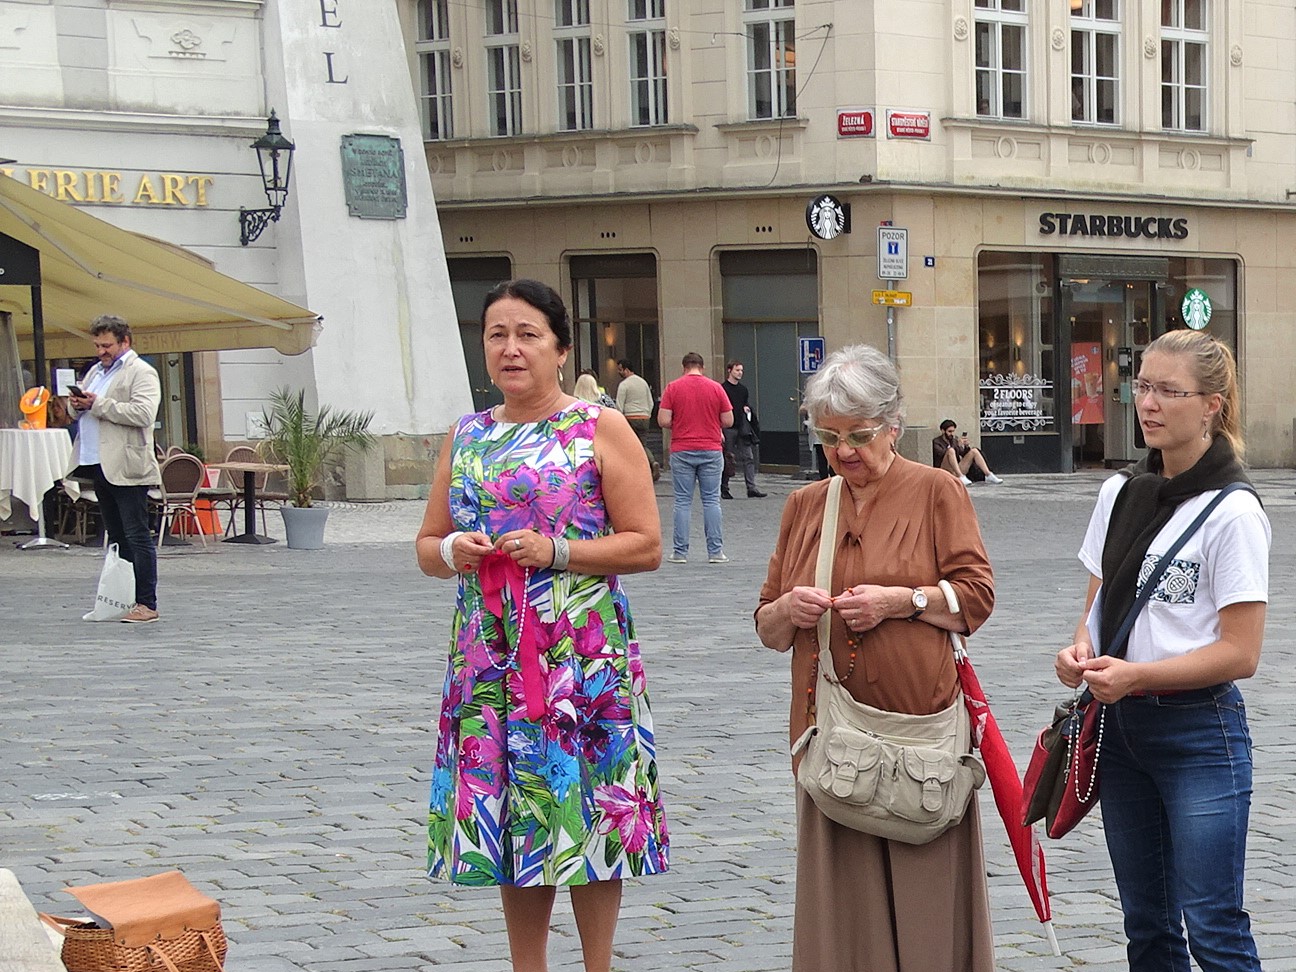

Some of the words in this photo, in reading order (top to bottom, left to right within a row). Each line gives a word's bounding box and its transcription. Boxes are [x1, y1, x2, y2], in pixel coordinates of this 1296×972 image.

[0, 167, 125, 203] ERIE
[133, 174, 214, 207] ART
[1039, 212, 1189, 240] STARBUCKS
[881, 231, 905, 241] POZOR
[993, 388, 1000, 399] 2
[1000, 389, 1033, 399] FLOORS
